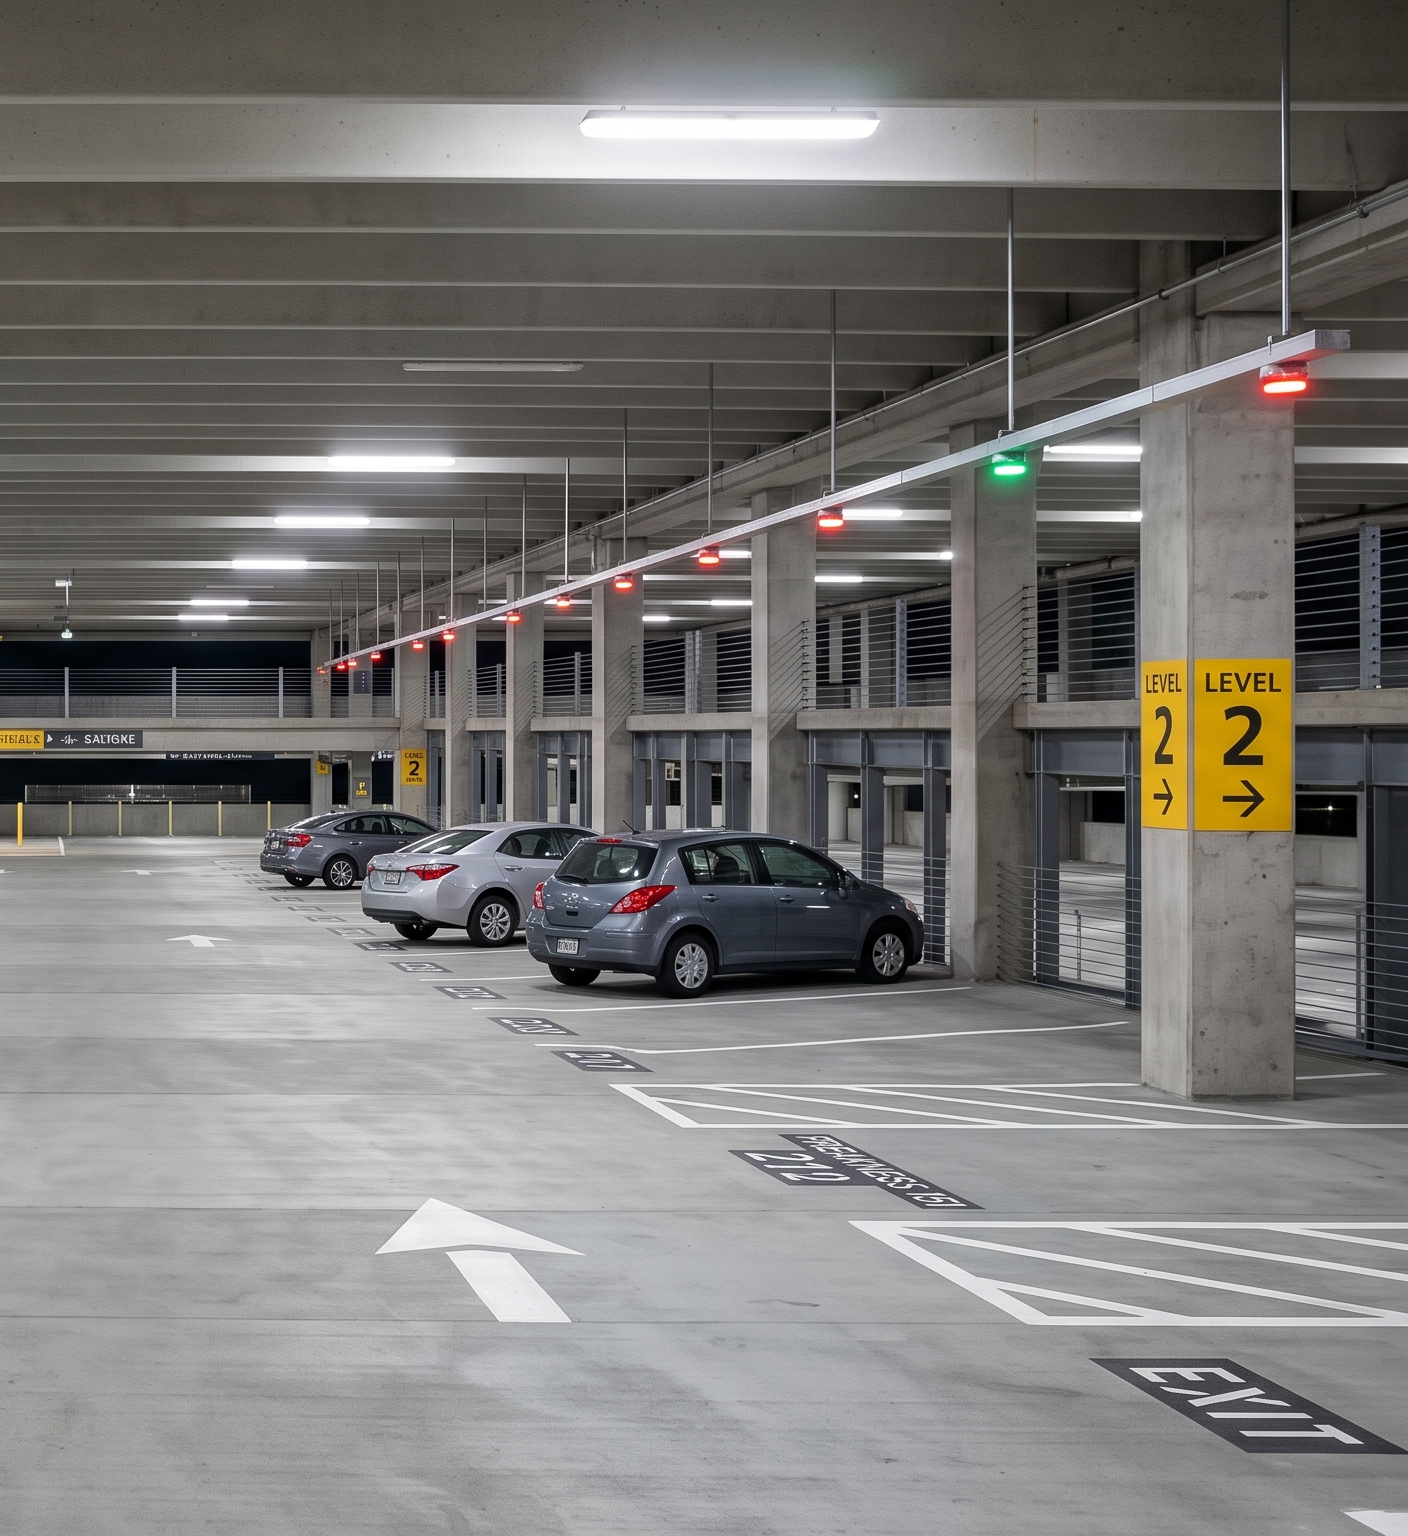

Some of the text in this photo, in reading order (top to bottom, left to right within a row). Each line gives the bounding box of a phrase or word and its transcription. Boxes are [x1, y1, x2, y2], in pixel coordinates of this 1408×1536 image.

[1145, 673, 1182, 693] LEVEL
[1205, 672, 1282, 693] LEVEL
[1154, 705, 1174, 764] 2
[1223, 705, 1264, 766] 2
[409, 760, 420, 776] 2
[744, 1152, 850, 1181] 212
[795, 1135, 929, 1189] PREAKNESS
[1129, 1367, 1365, 1444] EXIT
